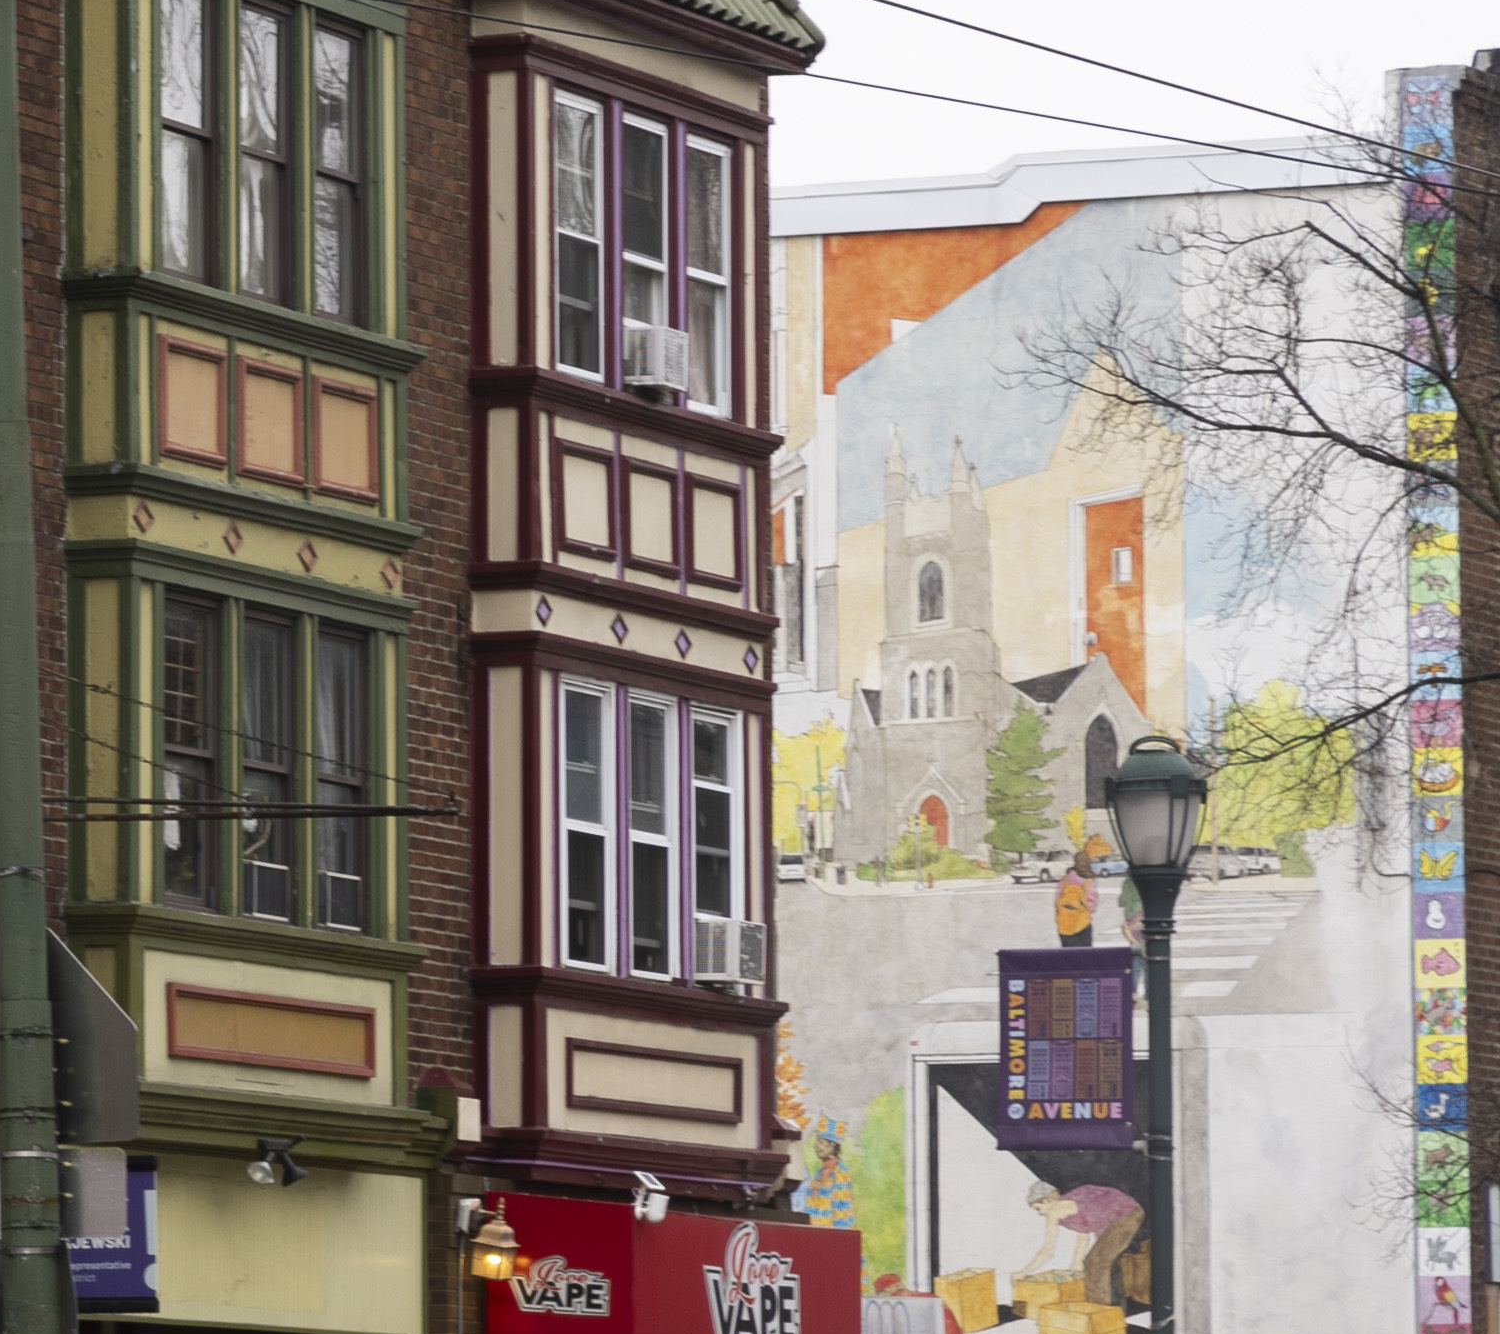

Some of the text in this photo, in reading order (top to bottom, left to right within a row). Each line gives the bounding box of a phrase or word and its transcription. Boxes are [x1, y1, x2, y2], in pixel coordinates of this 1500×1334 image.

[1007, 979, 1026, 1100] BALTIMORE
[1027, 1102, 1124, 1120] AVENUE
[726, 1221, 796, 1305] Love
[515, 1277, 610, 1313] VAPE
